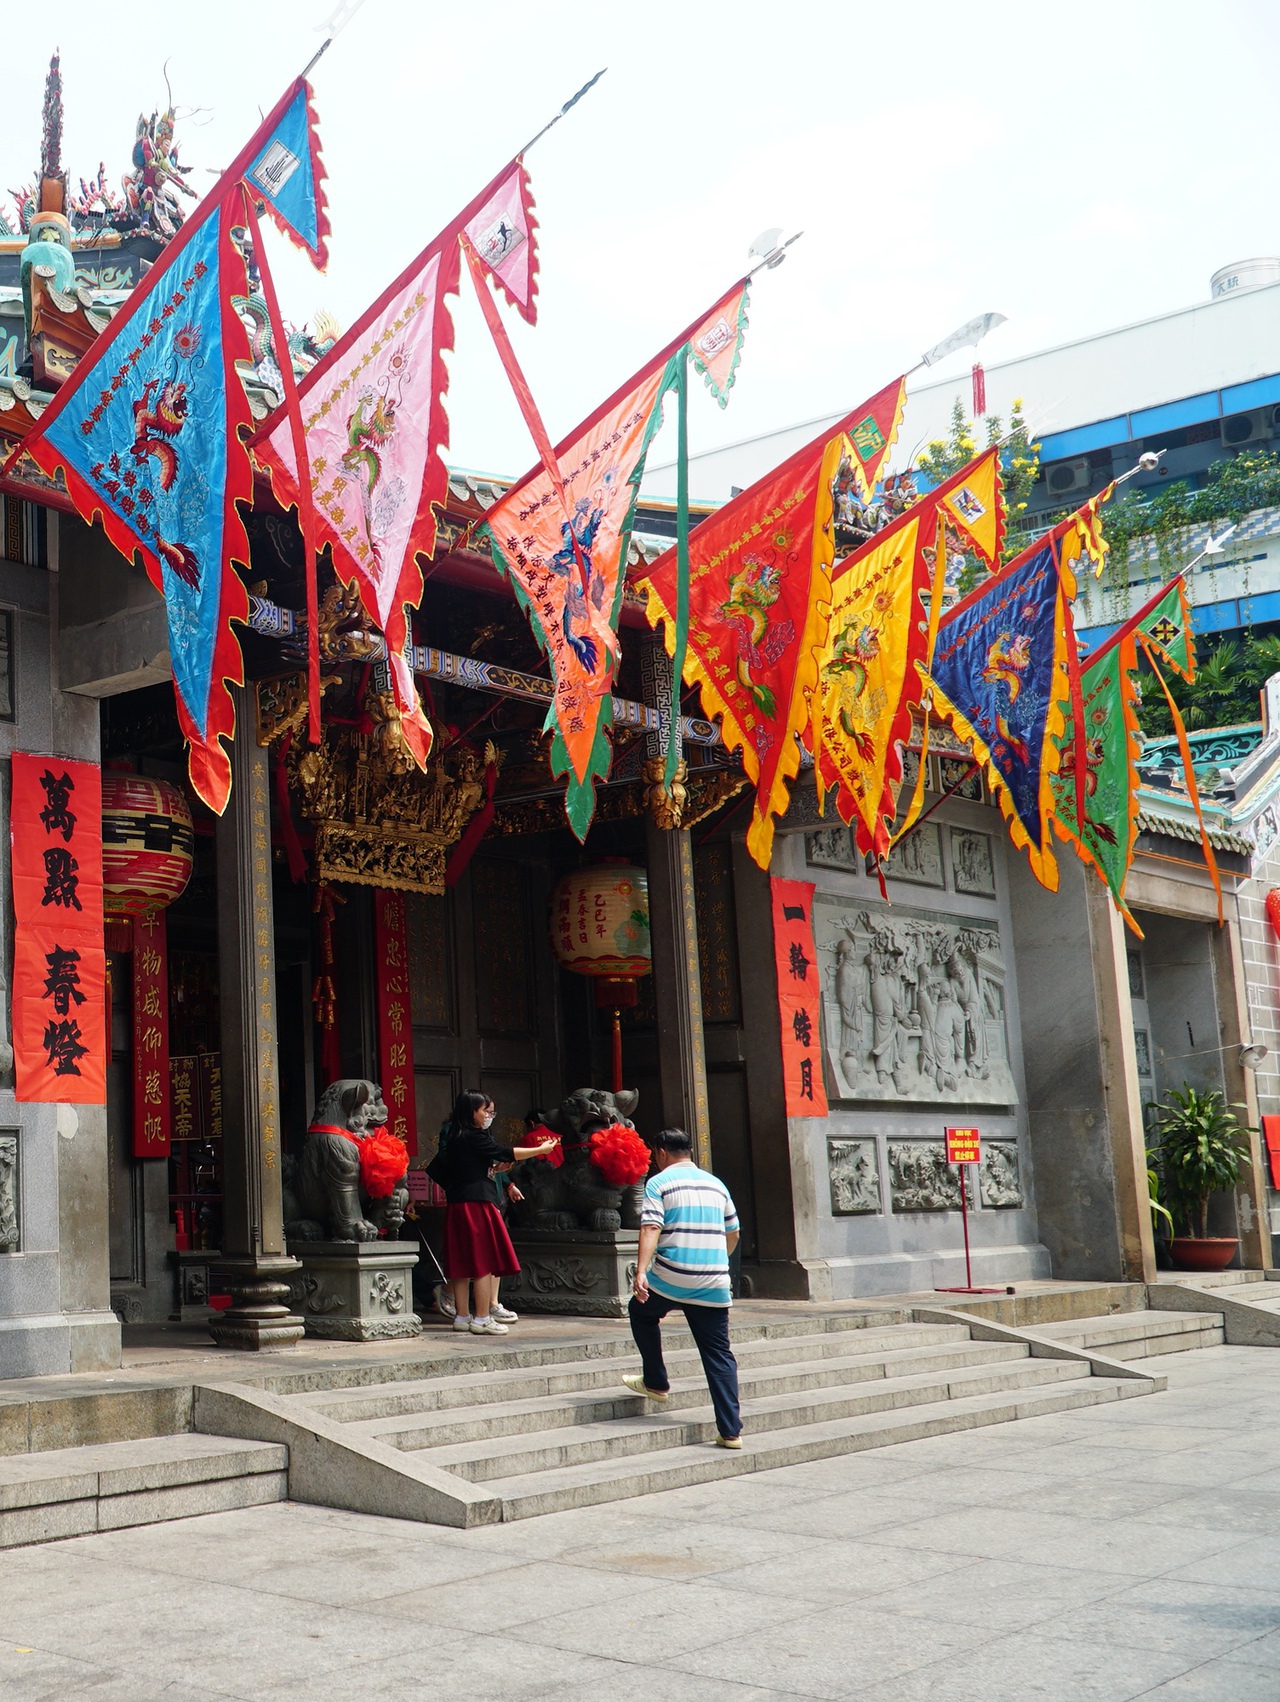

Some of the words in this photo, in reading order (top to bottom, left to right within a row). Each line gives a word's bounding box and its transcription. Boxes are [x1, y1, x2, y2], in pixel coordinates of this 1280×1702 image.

[39, 768, 92, 1077] 萬點春燈
[577, 888, 589, 944] 孟春吉日
[594, 894, 607, 939] 乙巳年
[171, 1071, 193, 1137] 協天上帝
